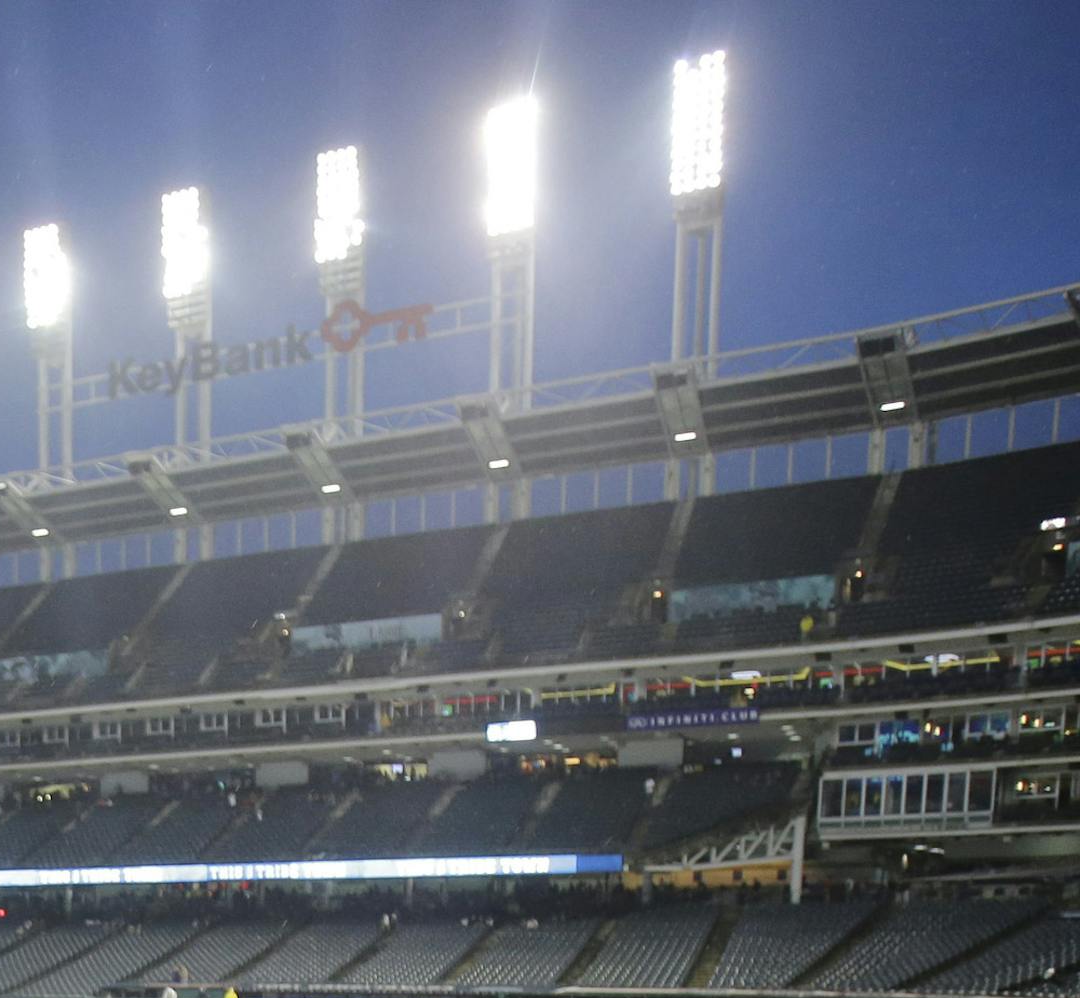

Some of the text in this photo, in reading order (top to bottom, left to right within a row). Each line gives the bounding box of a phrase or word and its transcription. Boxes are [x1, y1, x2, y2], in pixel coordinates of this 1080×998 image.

[108, 322, 315, 399] KeyBank
[650, 709, 758, 727] INFINITI CLUB
